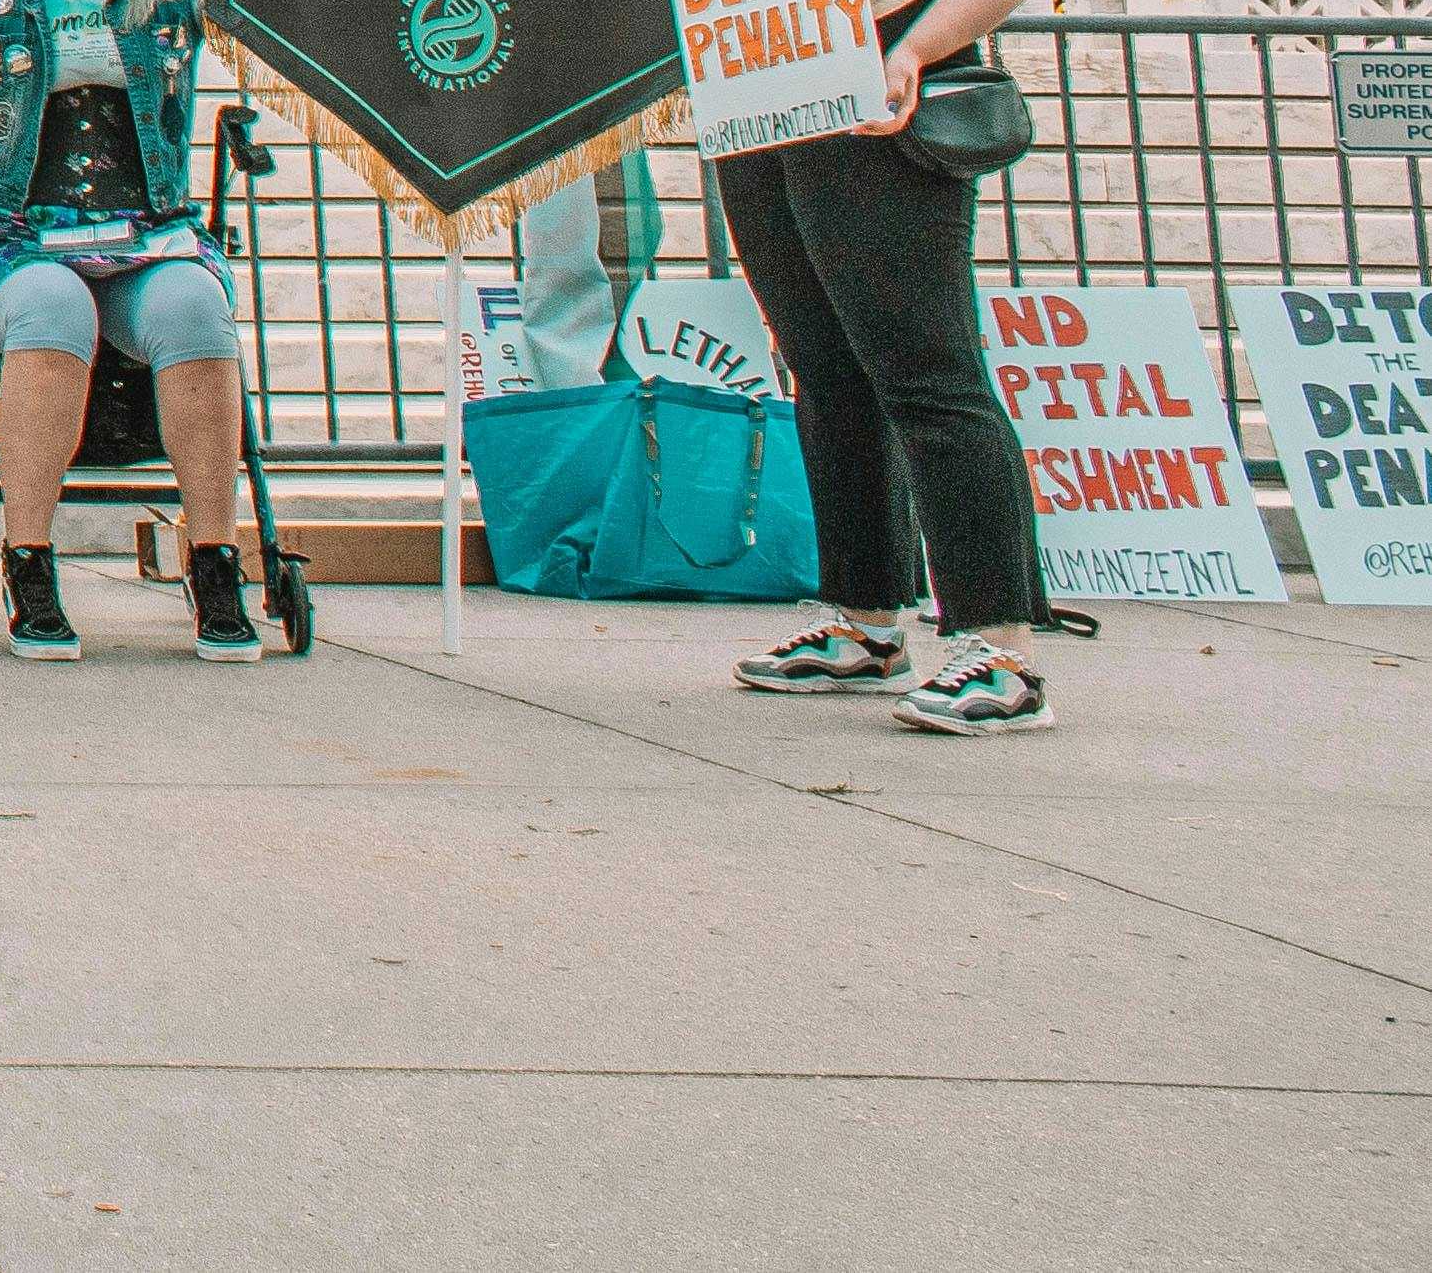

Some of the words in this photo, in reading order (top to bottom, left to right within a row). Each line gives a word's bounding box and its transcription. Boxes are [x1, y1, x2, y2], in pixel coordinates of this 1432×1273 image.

[1362, 63, 1432, 78] PROPE
[701, 94, 865, 153] @REHUMANIZEINTL
[980, 295, 1089, 351] ND
[1366, 351, 1422, 373] THE
[996, 363, 1193, 419] PITAL
[1305, 449, 1432, 510] PEN
